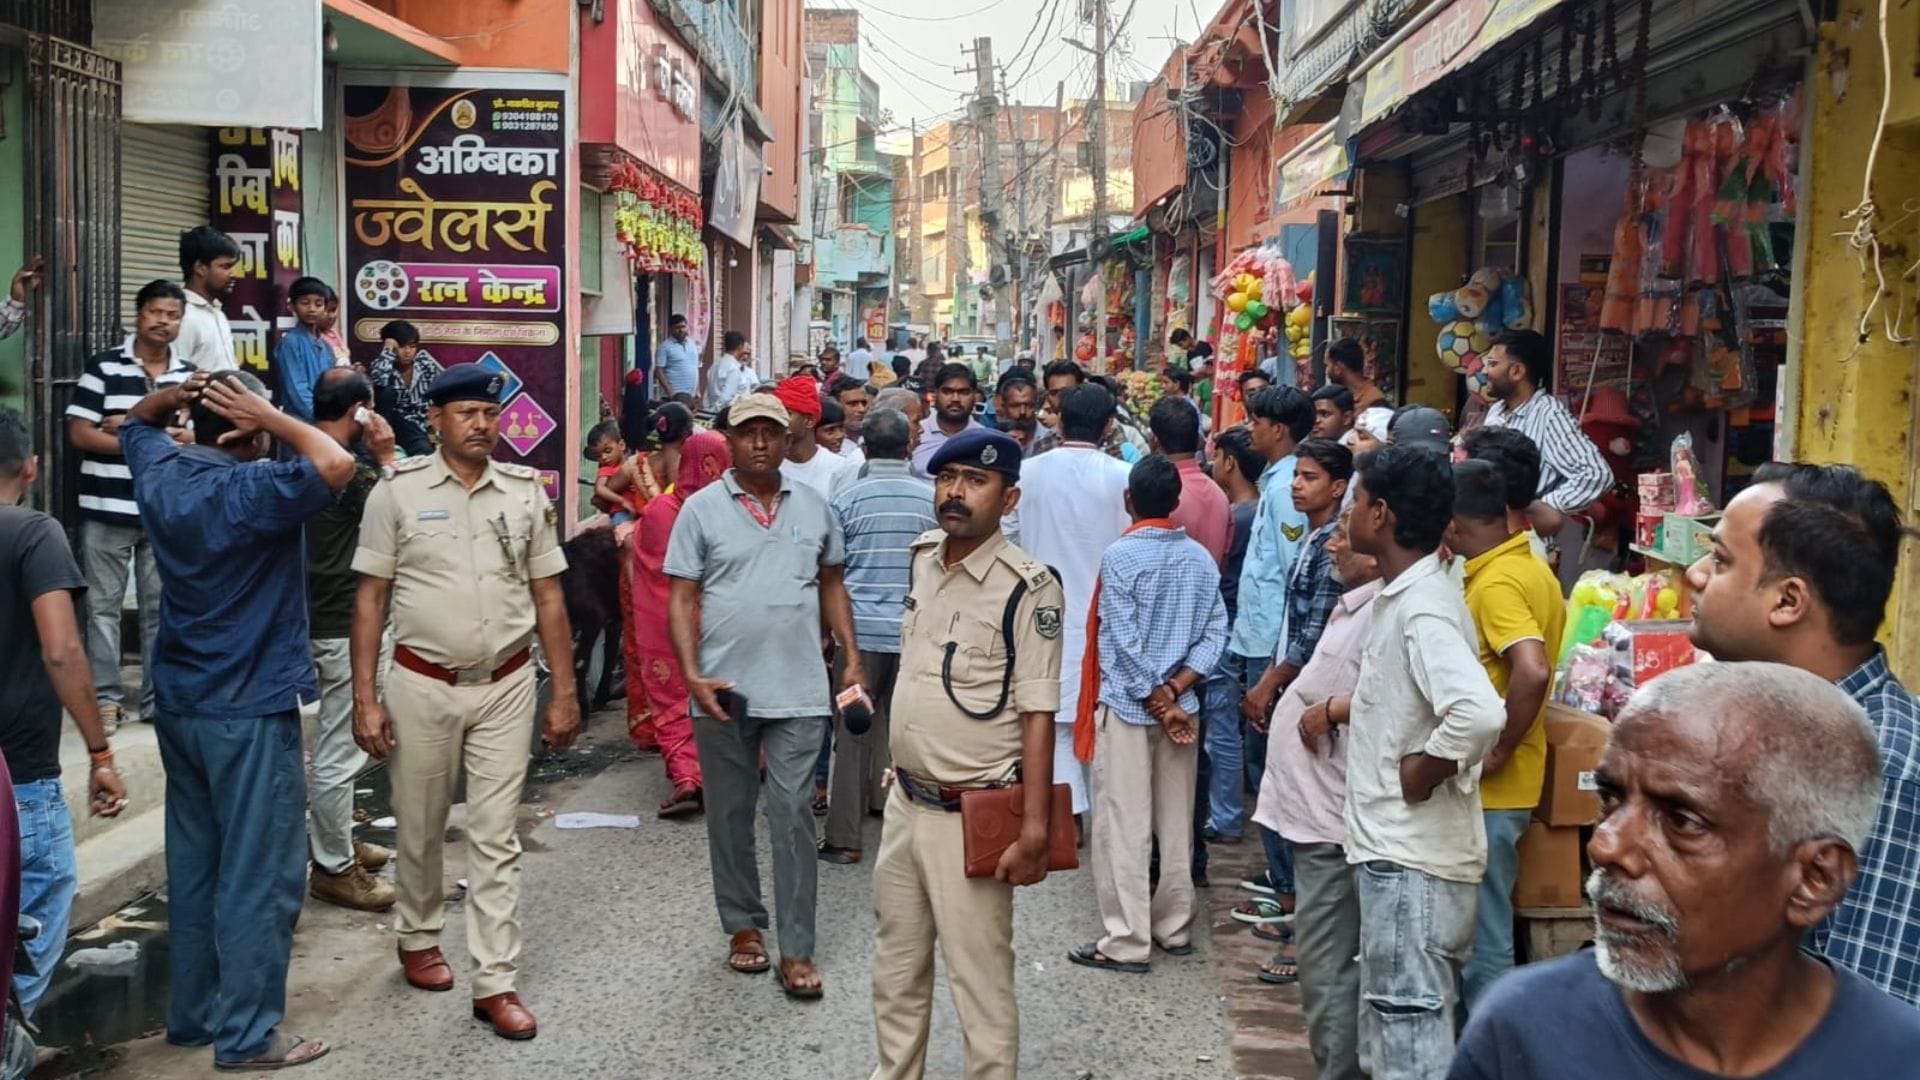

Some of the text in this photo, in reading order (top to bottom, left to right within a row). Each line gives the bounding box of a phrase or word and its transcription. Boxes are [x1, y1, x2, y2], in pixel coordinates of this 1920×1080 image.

[416, 134, 560, 176] अम्बिका
[353, 177, 558, 252] ज्वेलर्स
[414, 269, 547, 305] रत्न केन्द्र
